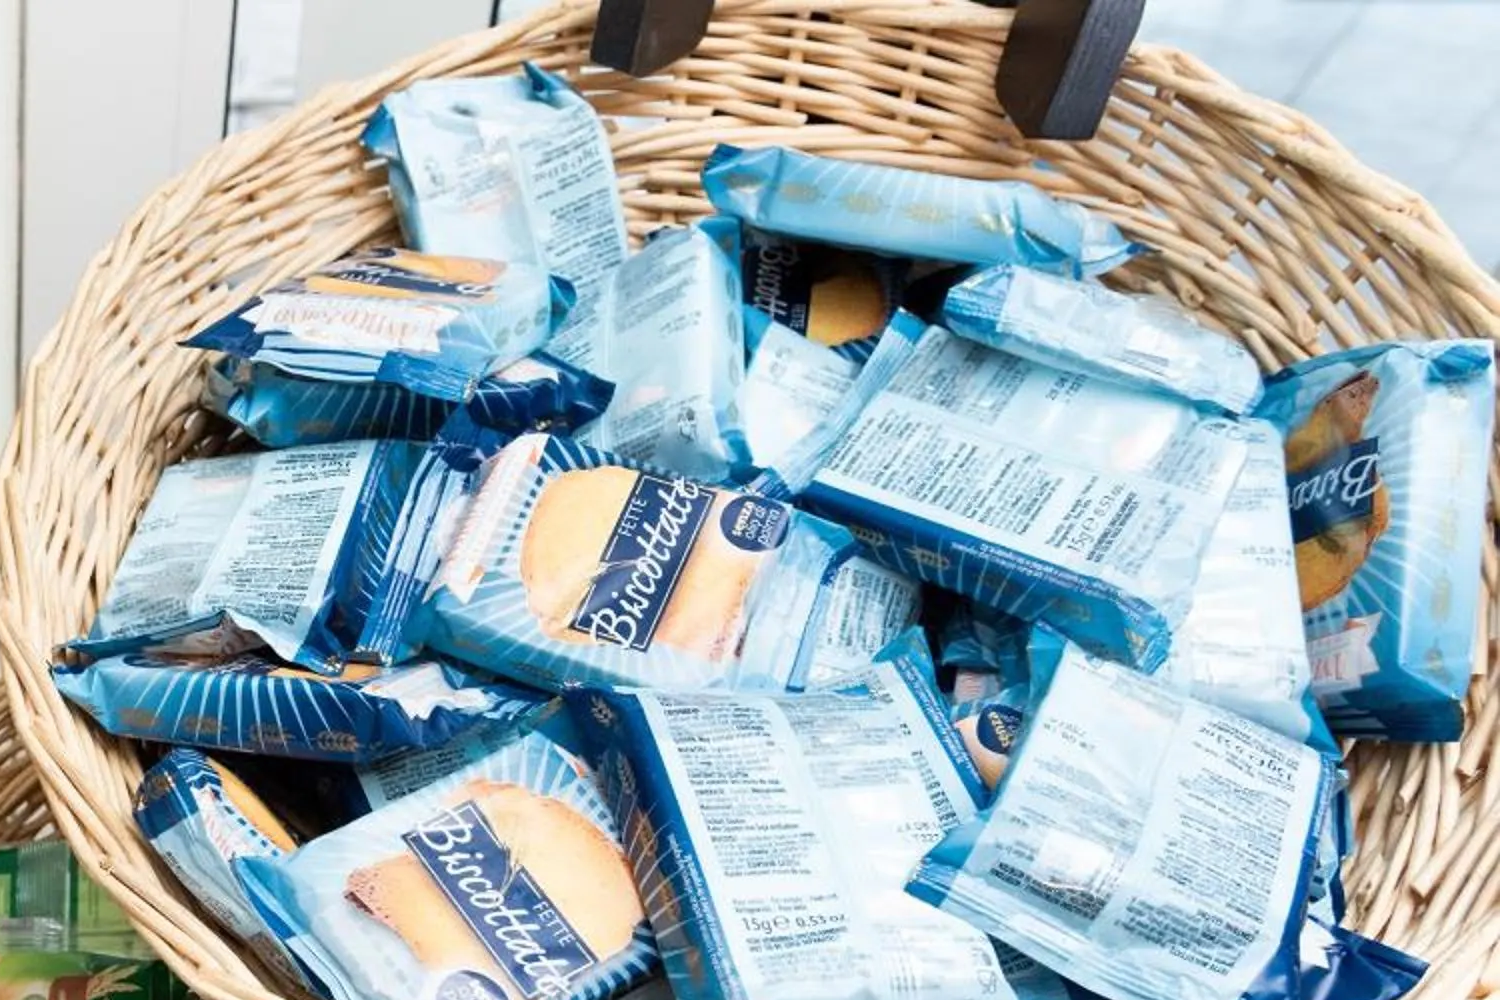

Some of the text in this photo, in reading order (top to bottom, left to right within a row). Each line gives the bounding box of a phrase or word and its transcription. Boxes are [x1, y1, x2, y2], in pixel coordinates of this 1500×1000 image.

[1288, 451, 1381, 512] Bisco
[620, 497, 648, 538] FETTE
[590, 476, 698, 651] Biscottate
[530, 900, 571, 948] FETTE
[742, 914, 774, 936] 15g
